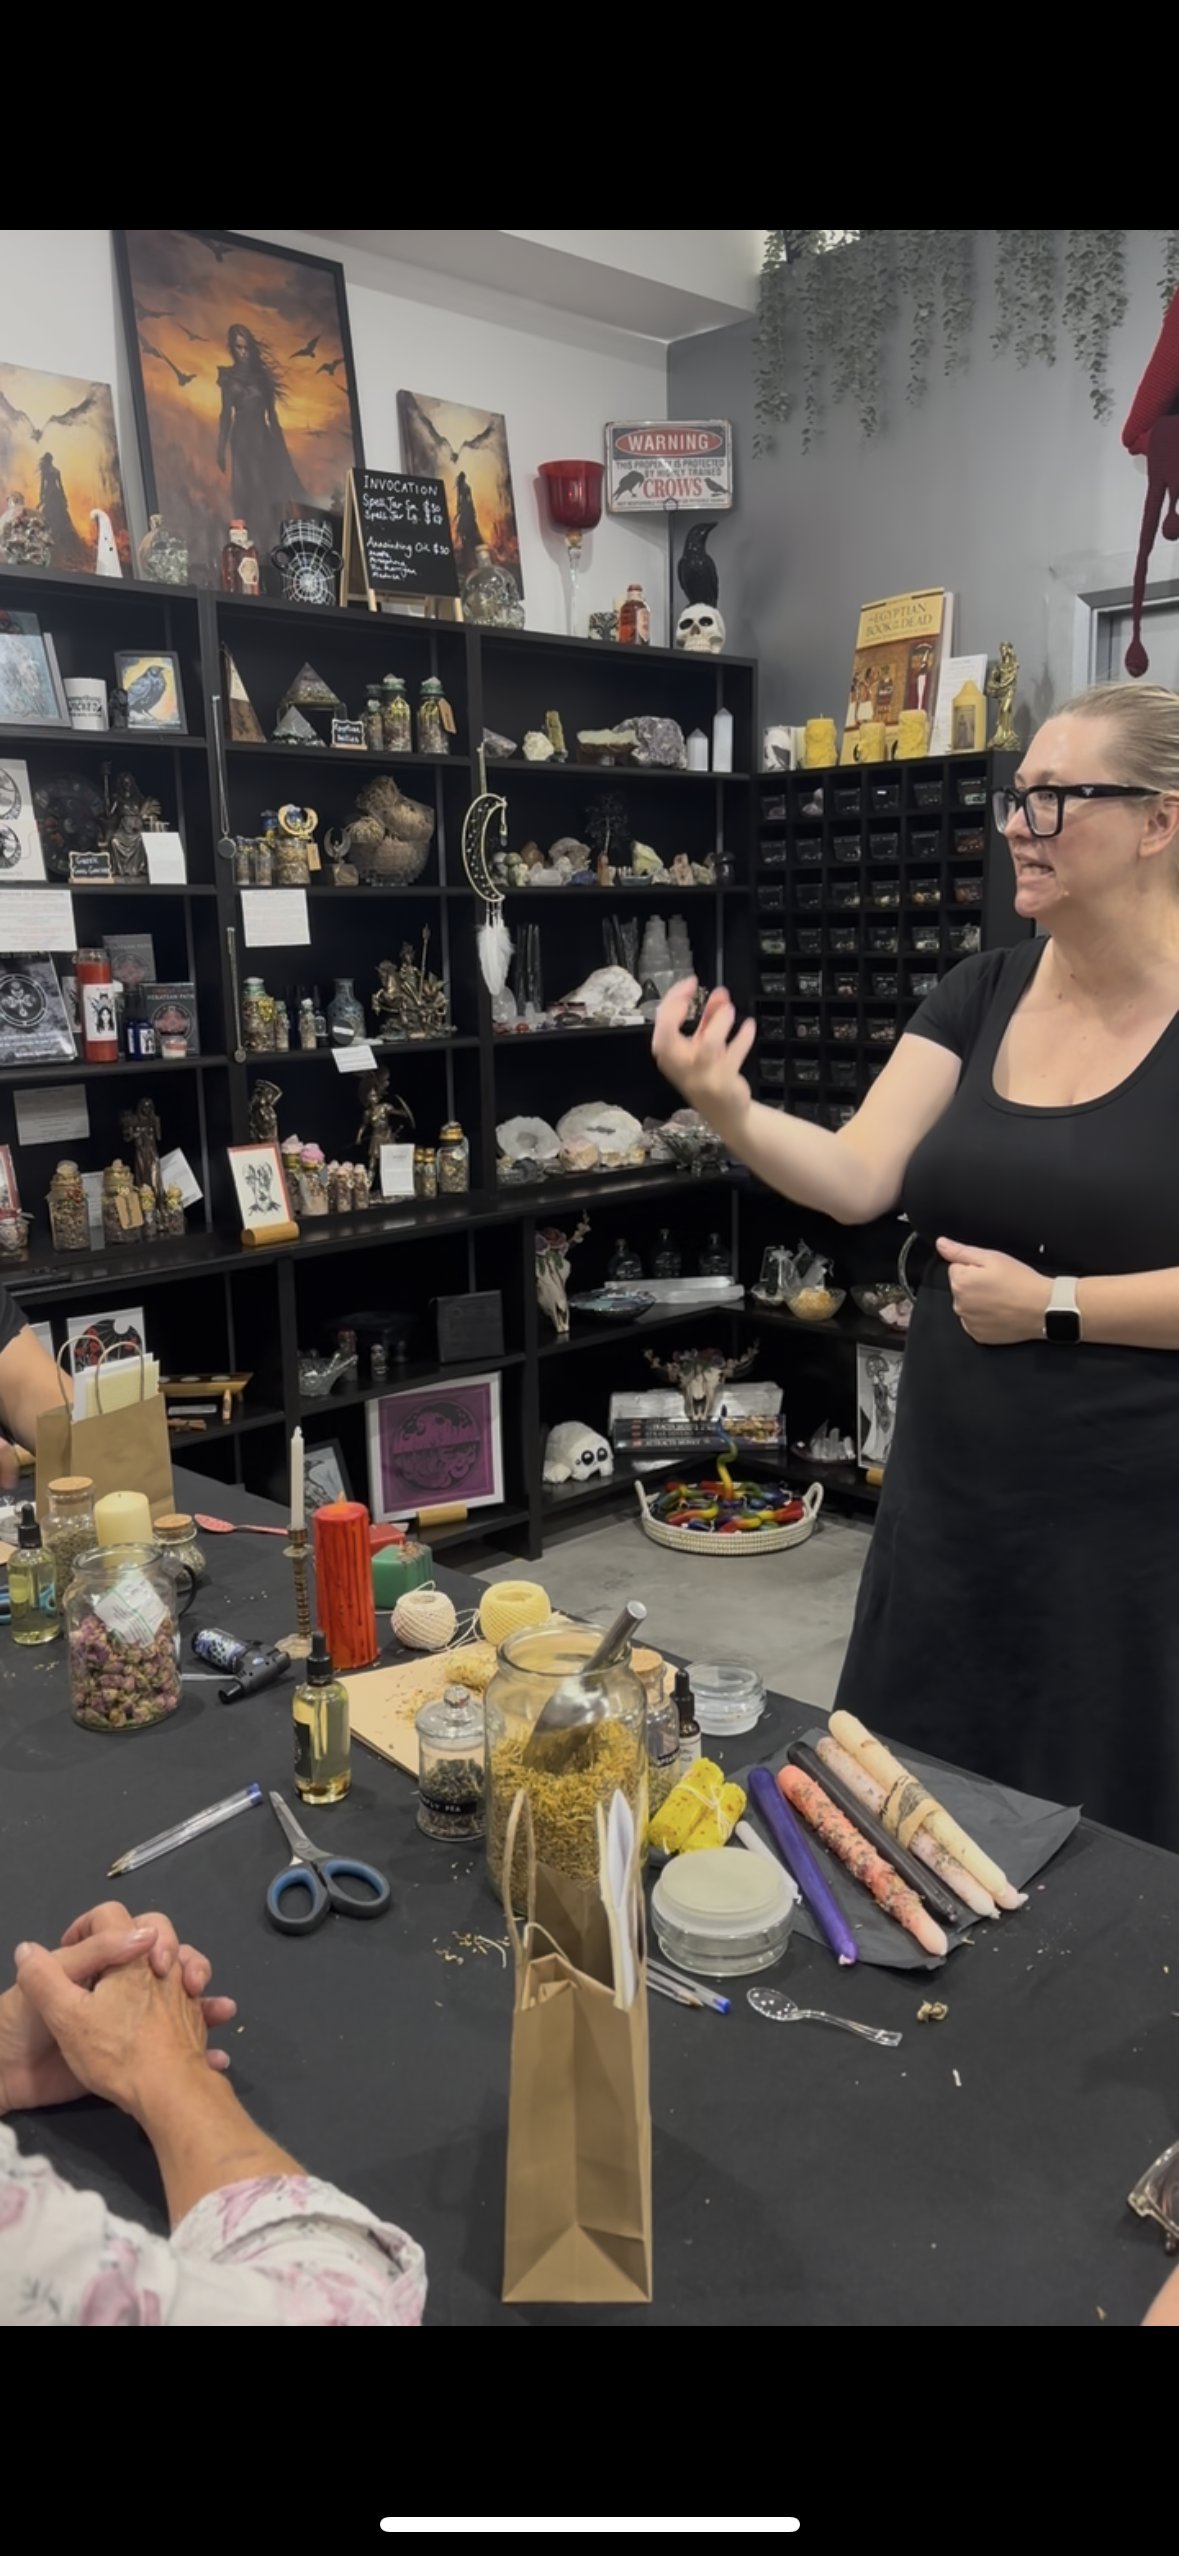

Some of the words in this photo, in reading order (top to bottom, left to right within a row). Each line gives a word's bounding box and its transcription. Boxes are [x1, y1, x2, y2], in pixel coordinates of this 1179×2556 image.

[629, 434, 709, 451] WARNING
[616, 462, 633, 470] THIS
[675, 460, 682, 468] IS
[683, 459, 725, 469] PROTECTED
[644, 470, 655, 478] BY
[688, 468, 722, 476] TRAINED
[364, 475, 438, 496] INVOCATION
[643, 478, 703, 498] CROWS
[874, 602, 927, 624] EGYPTIAN
[866, 621, 892, 637] BOOK
[901, 613, 933, 629] DEAD
